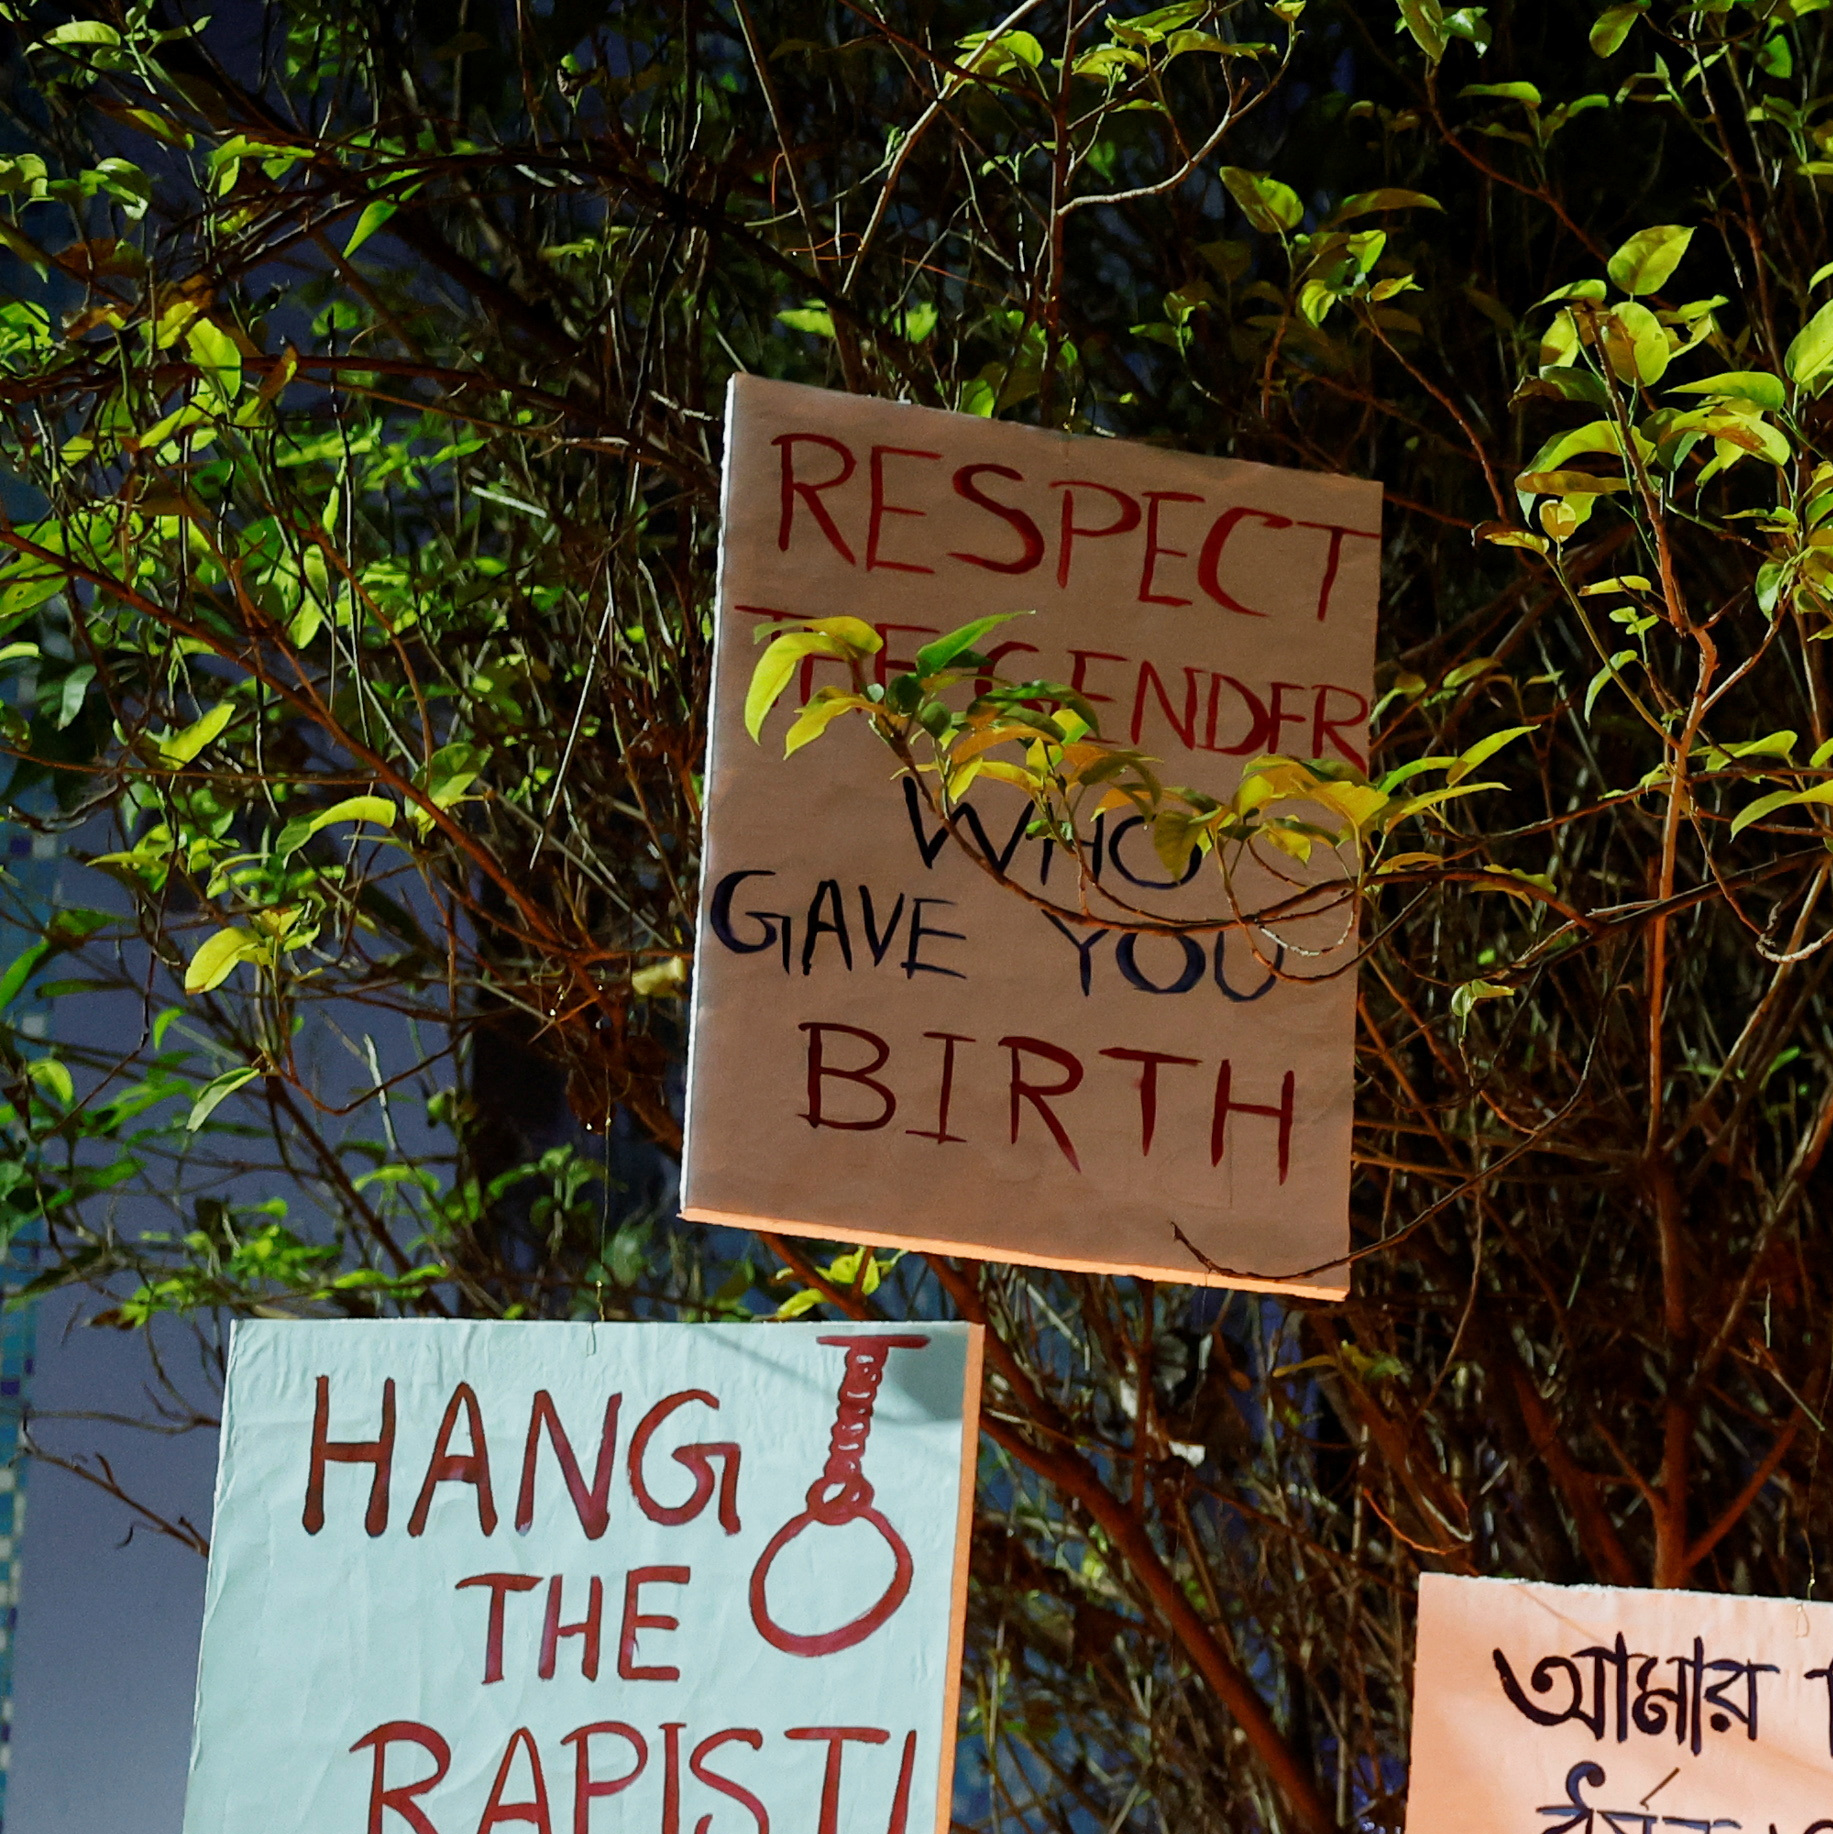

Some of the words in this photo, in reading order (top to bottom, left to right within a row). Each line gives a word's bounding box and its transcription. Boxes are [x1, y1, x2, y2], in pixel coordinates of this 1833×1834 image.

[772, 432, 1381, 622] RESPECT
[903, 776, 1202, 889] WHO
[710, 870, 967, 979] GAVE
[1041, 908, 1286, 1002] YOU
[798, 1021, 1295, 1186] BIRTH
[302, 1374, 742, 1541] HANG
[455, 1565, 692, 1685] THE
[1493, 1631, 1781, 1757] আমার
